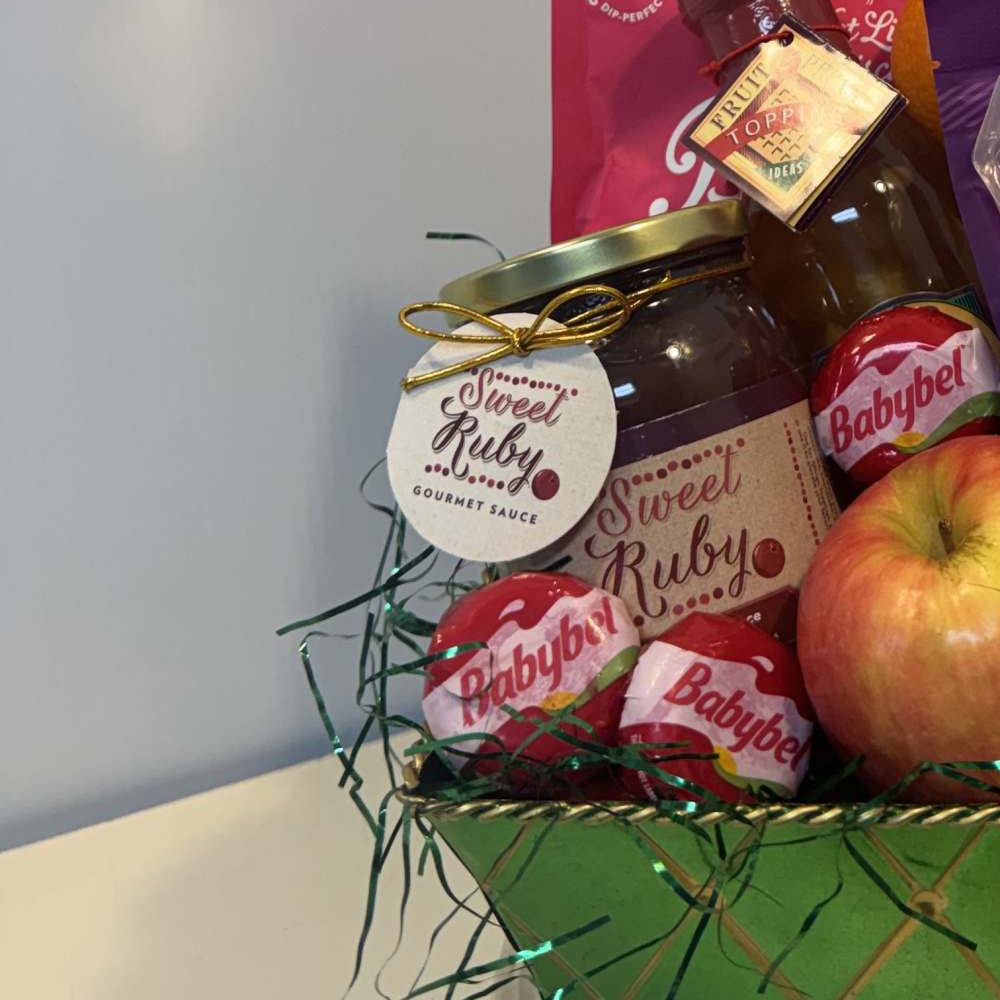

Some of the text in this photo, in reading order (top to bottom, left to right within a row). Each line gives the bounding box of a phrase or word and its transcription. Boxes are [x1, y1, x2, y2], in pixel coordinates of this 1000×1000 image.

[709, 62, 772, 132] FRUIT
[768, 161, 804, 180] IDEAS
[459, 367, 570, 427] Sweet
[830, 347, 965, 454] Babybel
[431, 396, 545, 496] Ruby
[597, 444, 742, 537] Sweet
[412, 485, 539, 525] GOURMET SAUCE
[584, 513, 753, 618] Ruby
[460, 596, 620, 728] Babybel
[662, 661, 811, 773] Babybel
